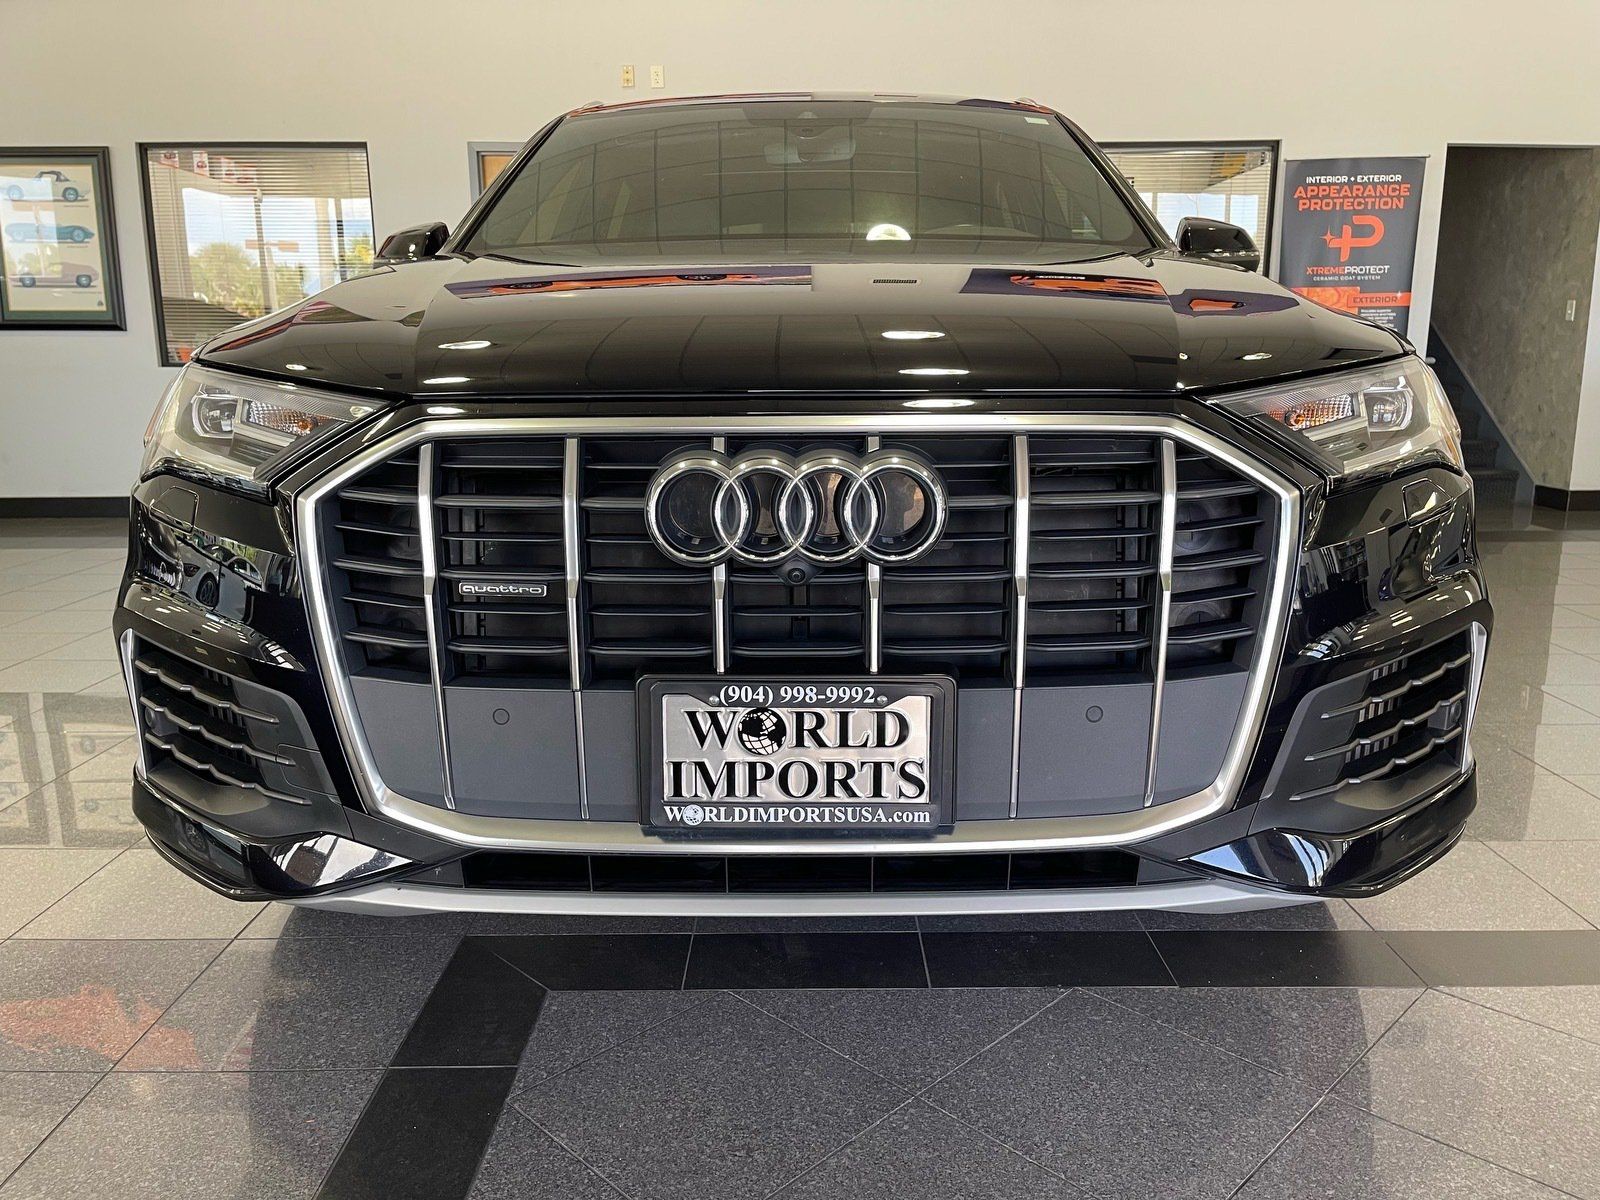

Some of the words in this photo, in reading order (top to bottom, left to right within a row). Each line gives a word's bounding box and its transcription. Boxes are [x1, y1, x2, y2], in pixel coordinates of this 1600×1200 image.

[1306, 176, 1348, 184] INTERIOR
[1357, 174, 1402, 183] EXTERIOR
[1294, 184, 1411, 198] APPEARANCE
[1298, 197, 1404, 211] PROTECTION
[1306, 265, 1390, 275] XTREMEPROTECT
[1352, 296, 1398, 304] EXTERIOR
[462, 585, 541, 593] quattro
[719, 685, 773, 706] (904)
[780, 686, 875, 704] 998-9992
[668, 758, 926, 798] IMPORTS
